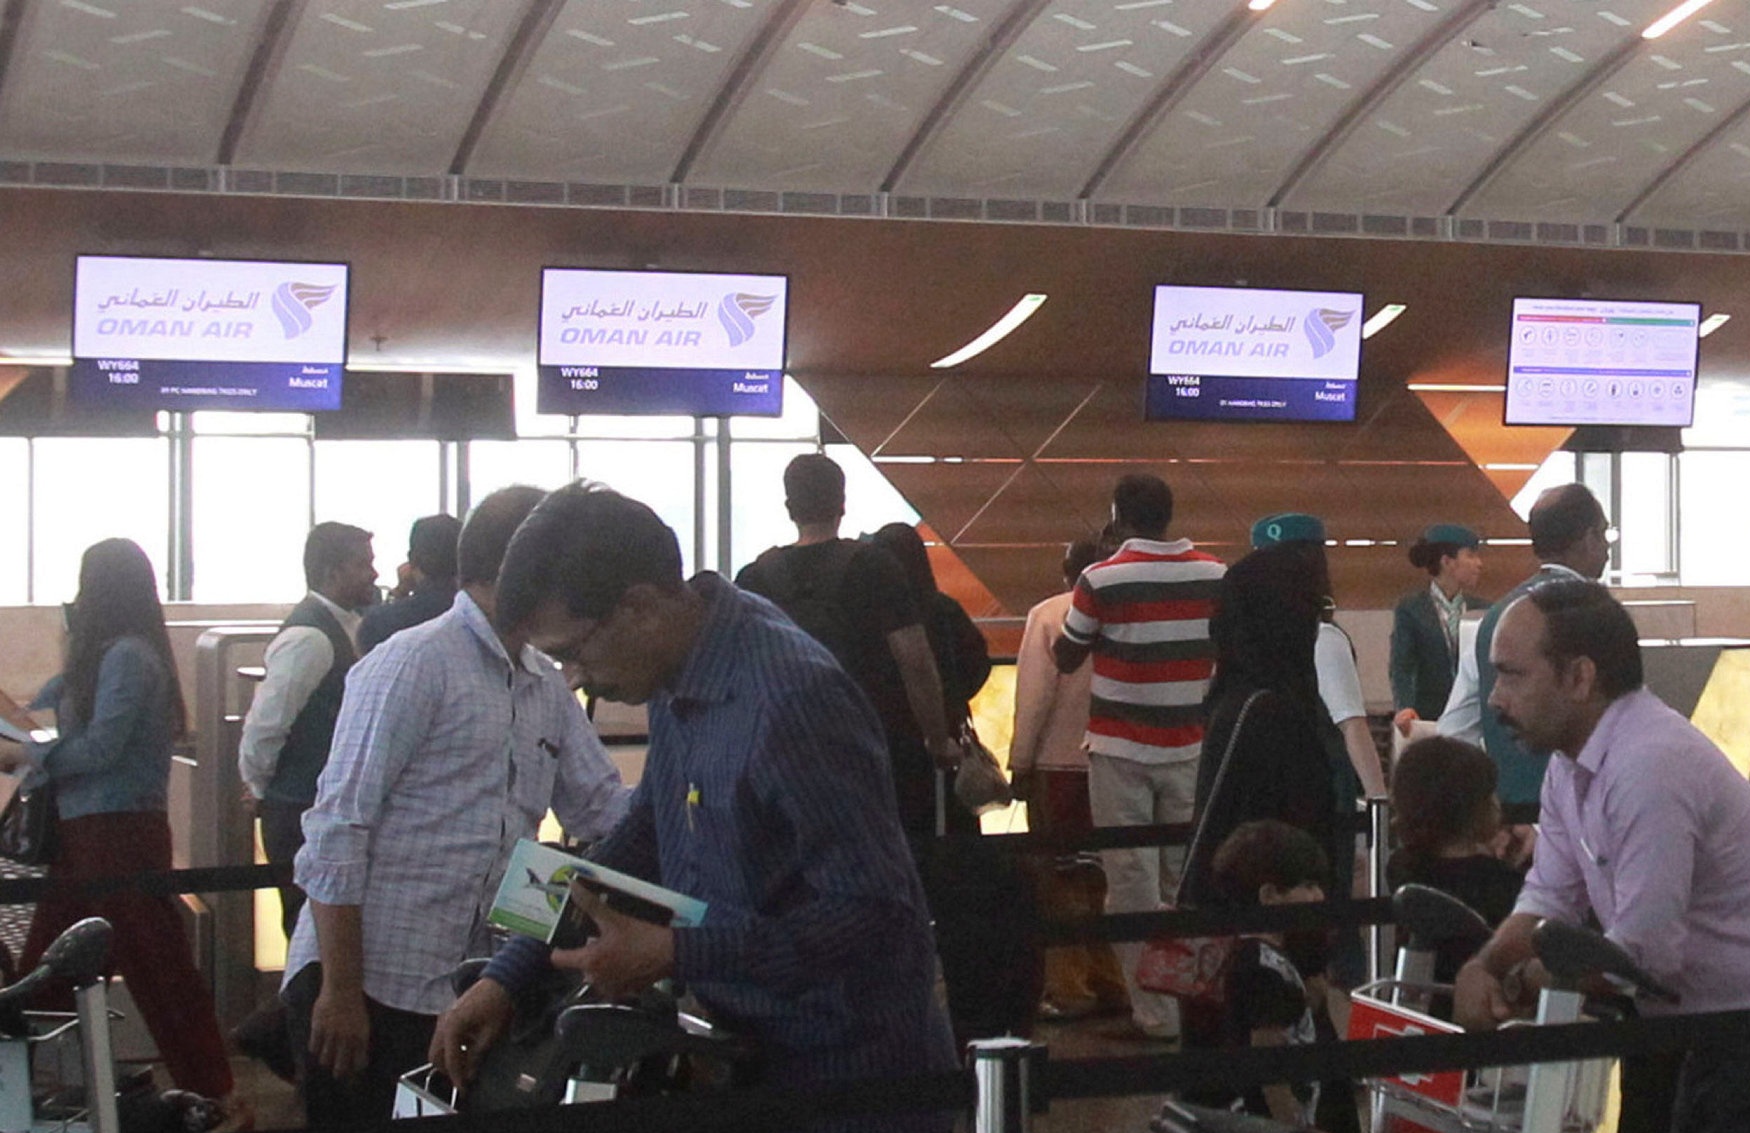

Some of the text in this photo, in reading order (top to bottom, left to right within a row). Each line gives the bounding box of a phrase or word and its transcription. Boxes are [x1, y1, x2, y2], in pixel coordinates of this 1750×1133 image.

[182, 290, 260, 312] الطيران
[638, 300, 709, 322] الطيران
[96, 318, 253, 338] OMAN AIR
[1235, 315, 1296, 335] الطيران
[560, 328, 702, 346] OMAN AIR
[1168, 340, 1290, 357] OMAN AIR
[97, 360, 139, 371] WY664
[561, 367, 598, 377] WY664
[108, 373, 139, 384] 16:00
[288, 377, 328, 388] Muscat
[571, 380, 598, 390] 16:00
[733, 382, 769, 393] Muscat
